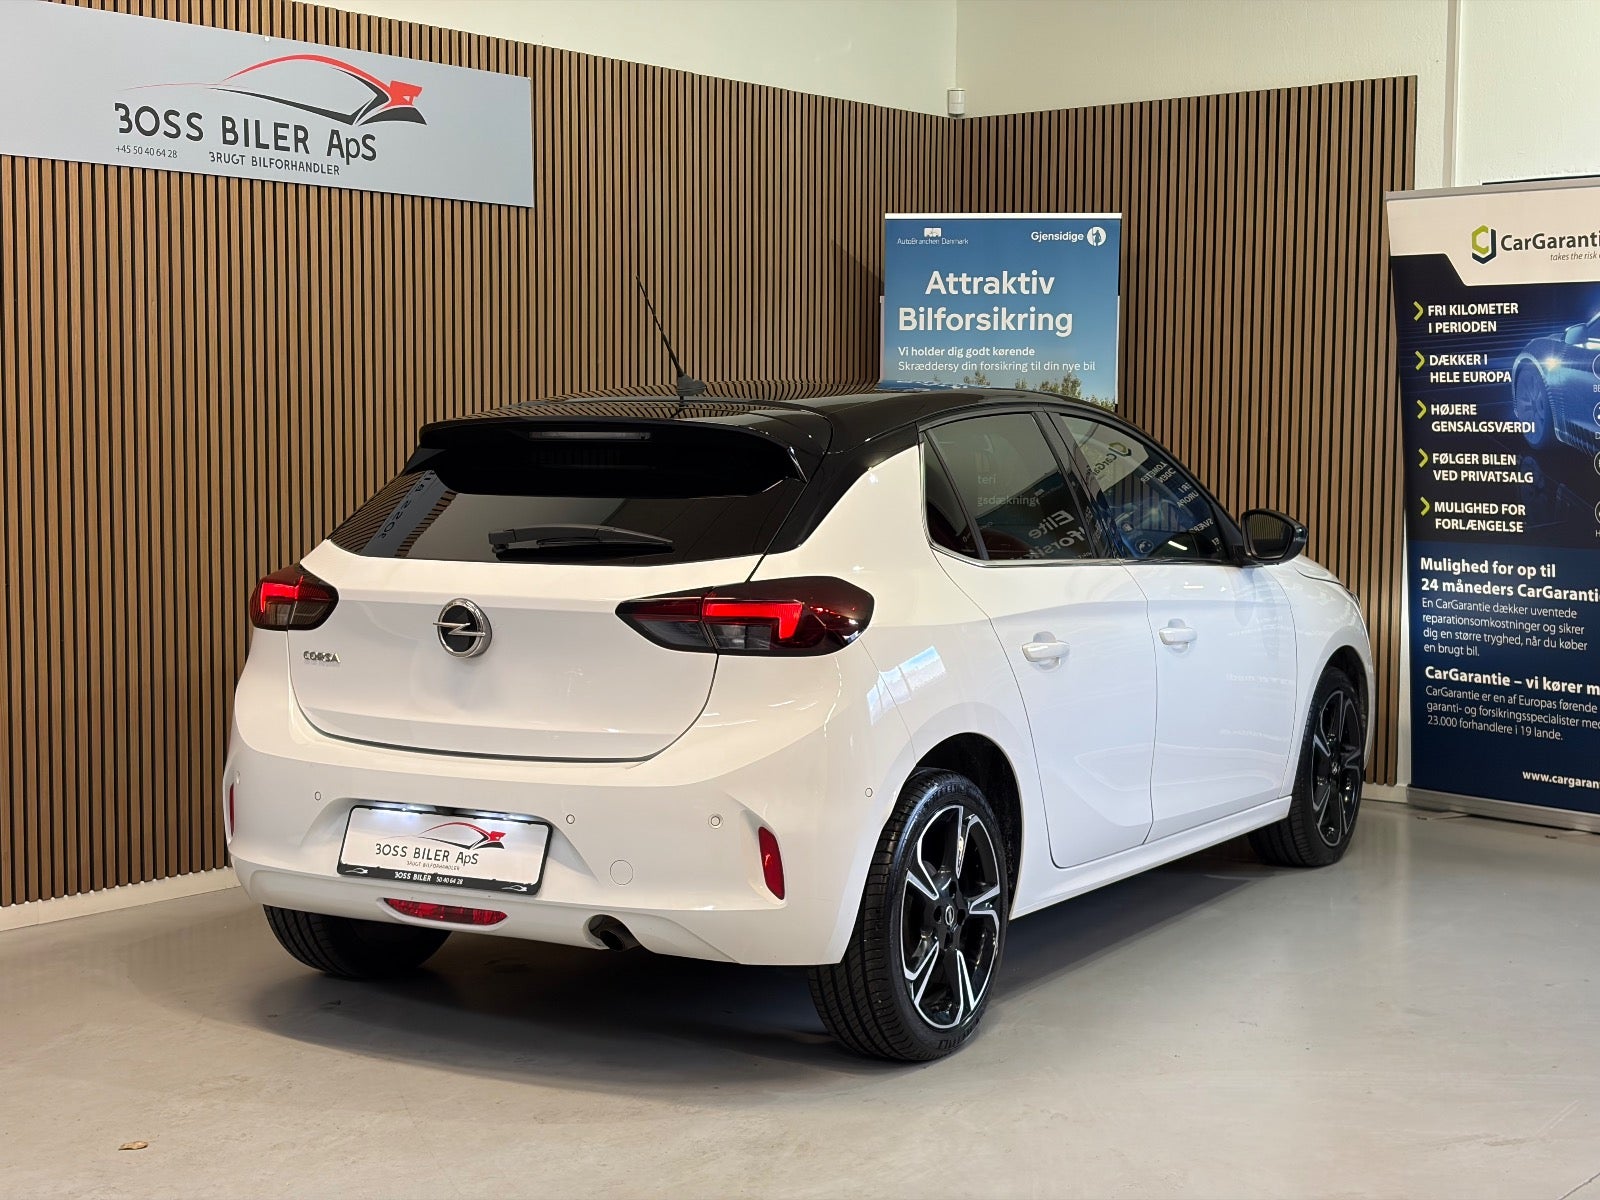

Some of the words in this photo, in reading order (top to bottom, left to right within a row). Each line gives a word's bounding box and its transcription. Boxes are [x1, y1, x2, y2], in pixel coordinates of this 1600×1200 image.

[221, 115, 310, 154] BILER
[326, 129, 377, 165] ApS
[115, 145, 131, 154] +45
[133, 146, 143, 155] 50
[144, 147, 155, 156] 40
[156, 148, 167, 158] 64
[167, 150, 178, 159] 28
[251, 156, 340, 176] BILFORHANDLER
[896, 237, 940, 245] AutoBranchen
[941, 237, 969, 245] Danmark
[1031, 231, 1084, 243] Gjensidige
[1550, 252, 1569, 261] takes
[1570, 251, 1583, 260] the
[1584, 250, 1598, 259] risk
[925, 269, 1055, 295] Attraktiv
[1428, 304, 1446, 317] FRI
[1449, 302, 1519, 316] KILOMETER
[898, 306, 1073, 338] Bilforsikring
[1428, 323, 1432, 333] I
[1435, 321, 1497, 333] PERIODEN
[898, 347, 909, 356] Vi
[911, 347, 945, 356] holder
[947, 347, 964, 359] dig
[966, 347, 990, 359] godt
[993, 347, 1035, 356] kørende
[1429, 354, 1481, 366] DÆKKER
[1484, 354, 1488, 365] I
[898, 361, 959, 374] Skræddersy
[961, 361, 977, 371] din
[980, 361, 1028, 373] forsikring
[1030, 361, 1041, 371] til
[1043, 361, 1059, 371] din
[1062, 363, 1080, 374] nye
[1083, 361, 1096, 371] bil
[1430, 371, 1460, 383] HELE
[1463, 371, 1512, 383] EUROPA
[1431, 404, 1477, 416] HØJERE
[1431, 421, 1536, 433] GENSALGSVÆRDI
[1432, 453, 1479, 465] FØLGER
[1482, 453, 1517, 466] BILEN
[1433, 470, 1458, 481] VED
[1460, 470, 1534, 483] PRIVATSALG
[1434, 501, 1499, 514] MULIGHED
[1501, 504, 1526, 516] FOR
[1435, 518, 1524, 533] FORLÆNGELSE
[1420, 557, 1488, 575] Mulighed
[1492, 560, 1513, 575] for
[1517, 565, 1536, 579] op
[1540, 563, 1556, 578] til
[1421, 578, 1438, 592] 24
[1442, 579, 1514, 597] måneders
[1422, 597, 1433, 608] En
[1436, 598, 1490, 612] CarGarantie
[1493, 602, 1528, 615] dækker
[1530, 607, 1577, 619] uventede
[1423, 613, 1540, 632] reparationsomkostninger
[1543, 624, 1556, 635] og
[1558, 622, 1585, 635] sikrer
[1423, 627, 1438, 640] dig
[1440, 630, 1452, 639] en
[1454, 630, 1482, 641] større
[1483, 631, 1524, 646] tryghed,
[1525, 635, 1541, 647] når
[1543, 636, 1557, 649] du
[1559, 637, 1588, 651] køber
[303, 651, 341, 663] CORSA
[1423, 643, 1435, 652] en
[1438, 643, 1464, 657] brugt
[1466, 645, 1480, 657] bil.
[1425, 665, 1511, 687] CarGarantie
[1525, 676, 1539, 689] vi
[1543, 676, 1583, 694] kører
[1425, 685, 1480, 701] CarGarantie
[1482, 692, 1491, 701] er
[1493, 694, 1506, 703] en
[1507, 693, 1517, 704] af
[1519, 695, 1557, 710] Europas
[1559, 698, 1598, 714] førende
[1426, 701, 1462, 713] garanti-
[1464, 706, 1477, 717] og
[1479, 705, 1579, 727] forsikringsspecialister
[1427, 714, 1457, 727] 23.000
[1459, 716, 1513, 734] forhandlere
[1521, 725, 1531, 736] 19
[1534, 727, 1563, 741] lande.
[413, 846, 450, 863] BILER
[455, 851, 479, 867] ApS
[412, 873, 432, 882] BILER
